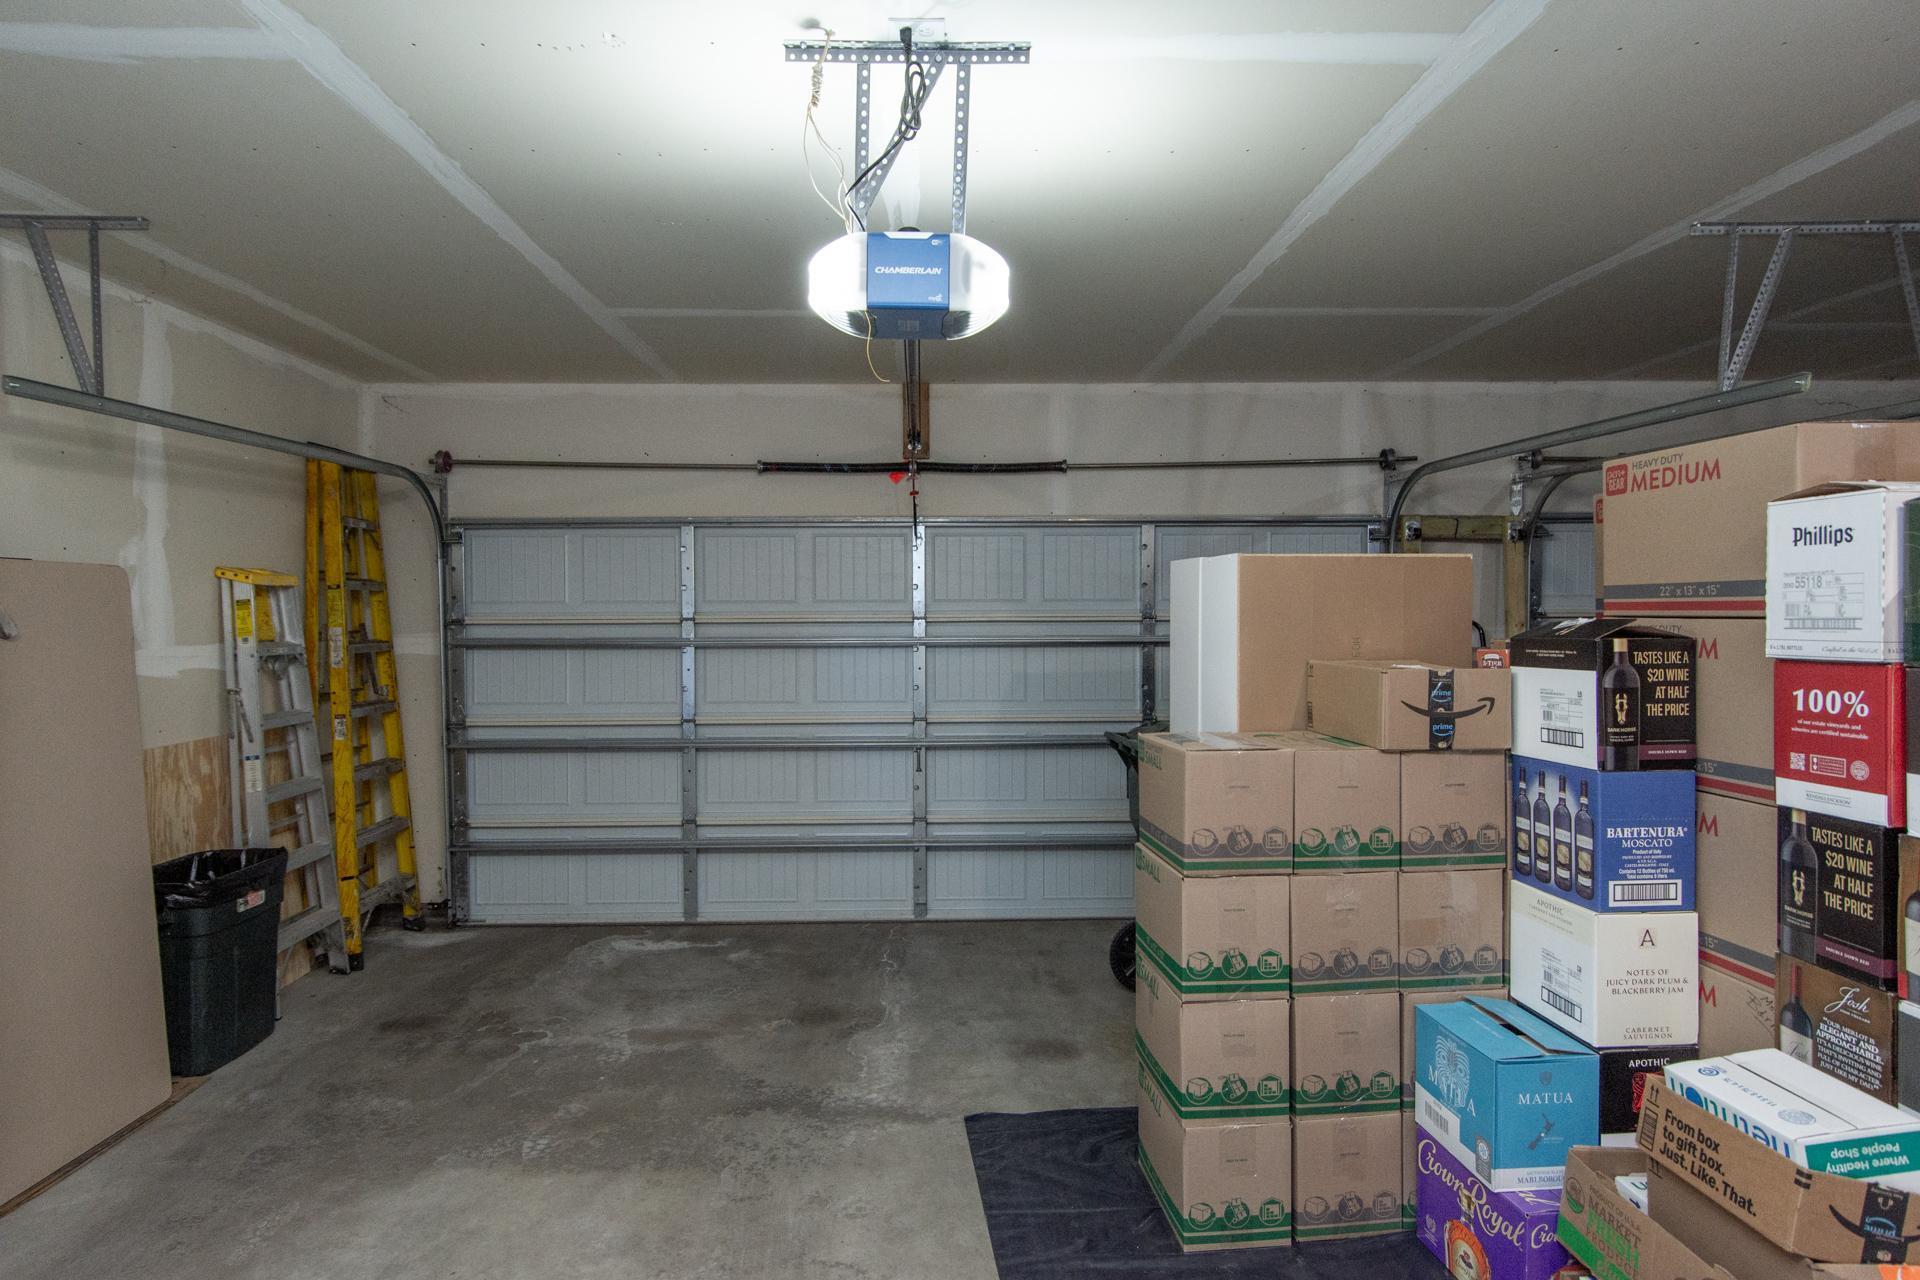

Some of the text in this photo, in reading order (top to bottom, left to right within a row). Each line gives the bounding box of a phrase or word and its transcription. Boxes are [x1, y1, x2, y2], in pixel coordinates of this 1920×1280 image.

[874, 266, 943, 275] CHAMBERLAIN
[1632, 453, 1683, 470] HEAVY DUTY
[1631, 457, 1721, 493] MEDIUM
[1792, 525, 1854, 547] Phillips
[1794, 575, 1822, 589] 55118
[1633, 651, 1689, 665] TASTES LIKE A
[1647, 668, 1689, 682] $20 WINE
[1655, 686, 1690, 699] AT HALF
[1646, 703, 1690, 717] THE PRICE
[1792, 688, 1870, 718] 100%
[1621, 838, 1673, 848] MOSCATO
[1811, 826, 1873, 856] TASTES LIKE A
[1142, 855, 1161, 884] SMALL
[1825, 849, 1874, 877] $20 WINE
[1833, 873, 1873, 898] AT HALF
[1823, 890, 1874, 921] THE PRICE
[1639, 928, 1656, 947] A
[1606, 979, 1629, 987] JUICY
[1631, 978, 1655, 986] DARK
[1682, 977, 1689, 985] &
[1626, 968, 1668, 977] NOTES OF
[1611, 986, 1684, 995] BLACKBERRY JAM
[1824, 986, 1871, 1013] Josh
[1623, 1026, 1673, 1040] CABERNET SAUVIGNON
[1819, 1022, 1879, 1054] ELEGANT AND
[1841, 1026, 1868, 1042] MERLOT
[1869, 1037, 1875, 1045] IS
[1815, 1029, 1884, 1066] APPROACHABLE.
[1628, 1057, 1671, 1068] APOTHIC
[1817, 1051, 1832, 1062] FULL
[1831, 1058, 1841, 1067] OF
[1832, 1044, 1865, 1063] DELICIOUS
[1864, 1058, 1883, 1073] WINE
[1837, 1053, 1866, 1071] INVITING
[1866, 1067, 1882, 1079] AND
[1820, 1060, 1834, 1071] JUST
[1834, 1067, 1848, 1078] LIKE
[1848, 1073, 1859, 1083] MY
[1518, 1092, 1574, 1105] MATUA
[1664, 1108, 1721, 1154] From box
[1663, 1125, 1725, 1176] to gift box.
[1830, 1142, 1901, 1159] People Shop
[1825, 1154, 1909, 1174] Where Healthy
[1517, 1175, 1562, 1184] MARLBOROU
[1659, 1142, 1757, 1217] Just. Like. That.
[1418, 1139, 1468, 1192] Crown
[1467, 1177, 1525, 1246] Royal
[1531, 1223, 1557, 1249] Cro
